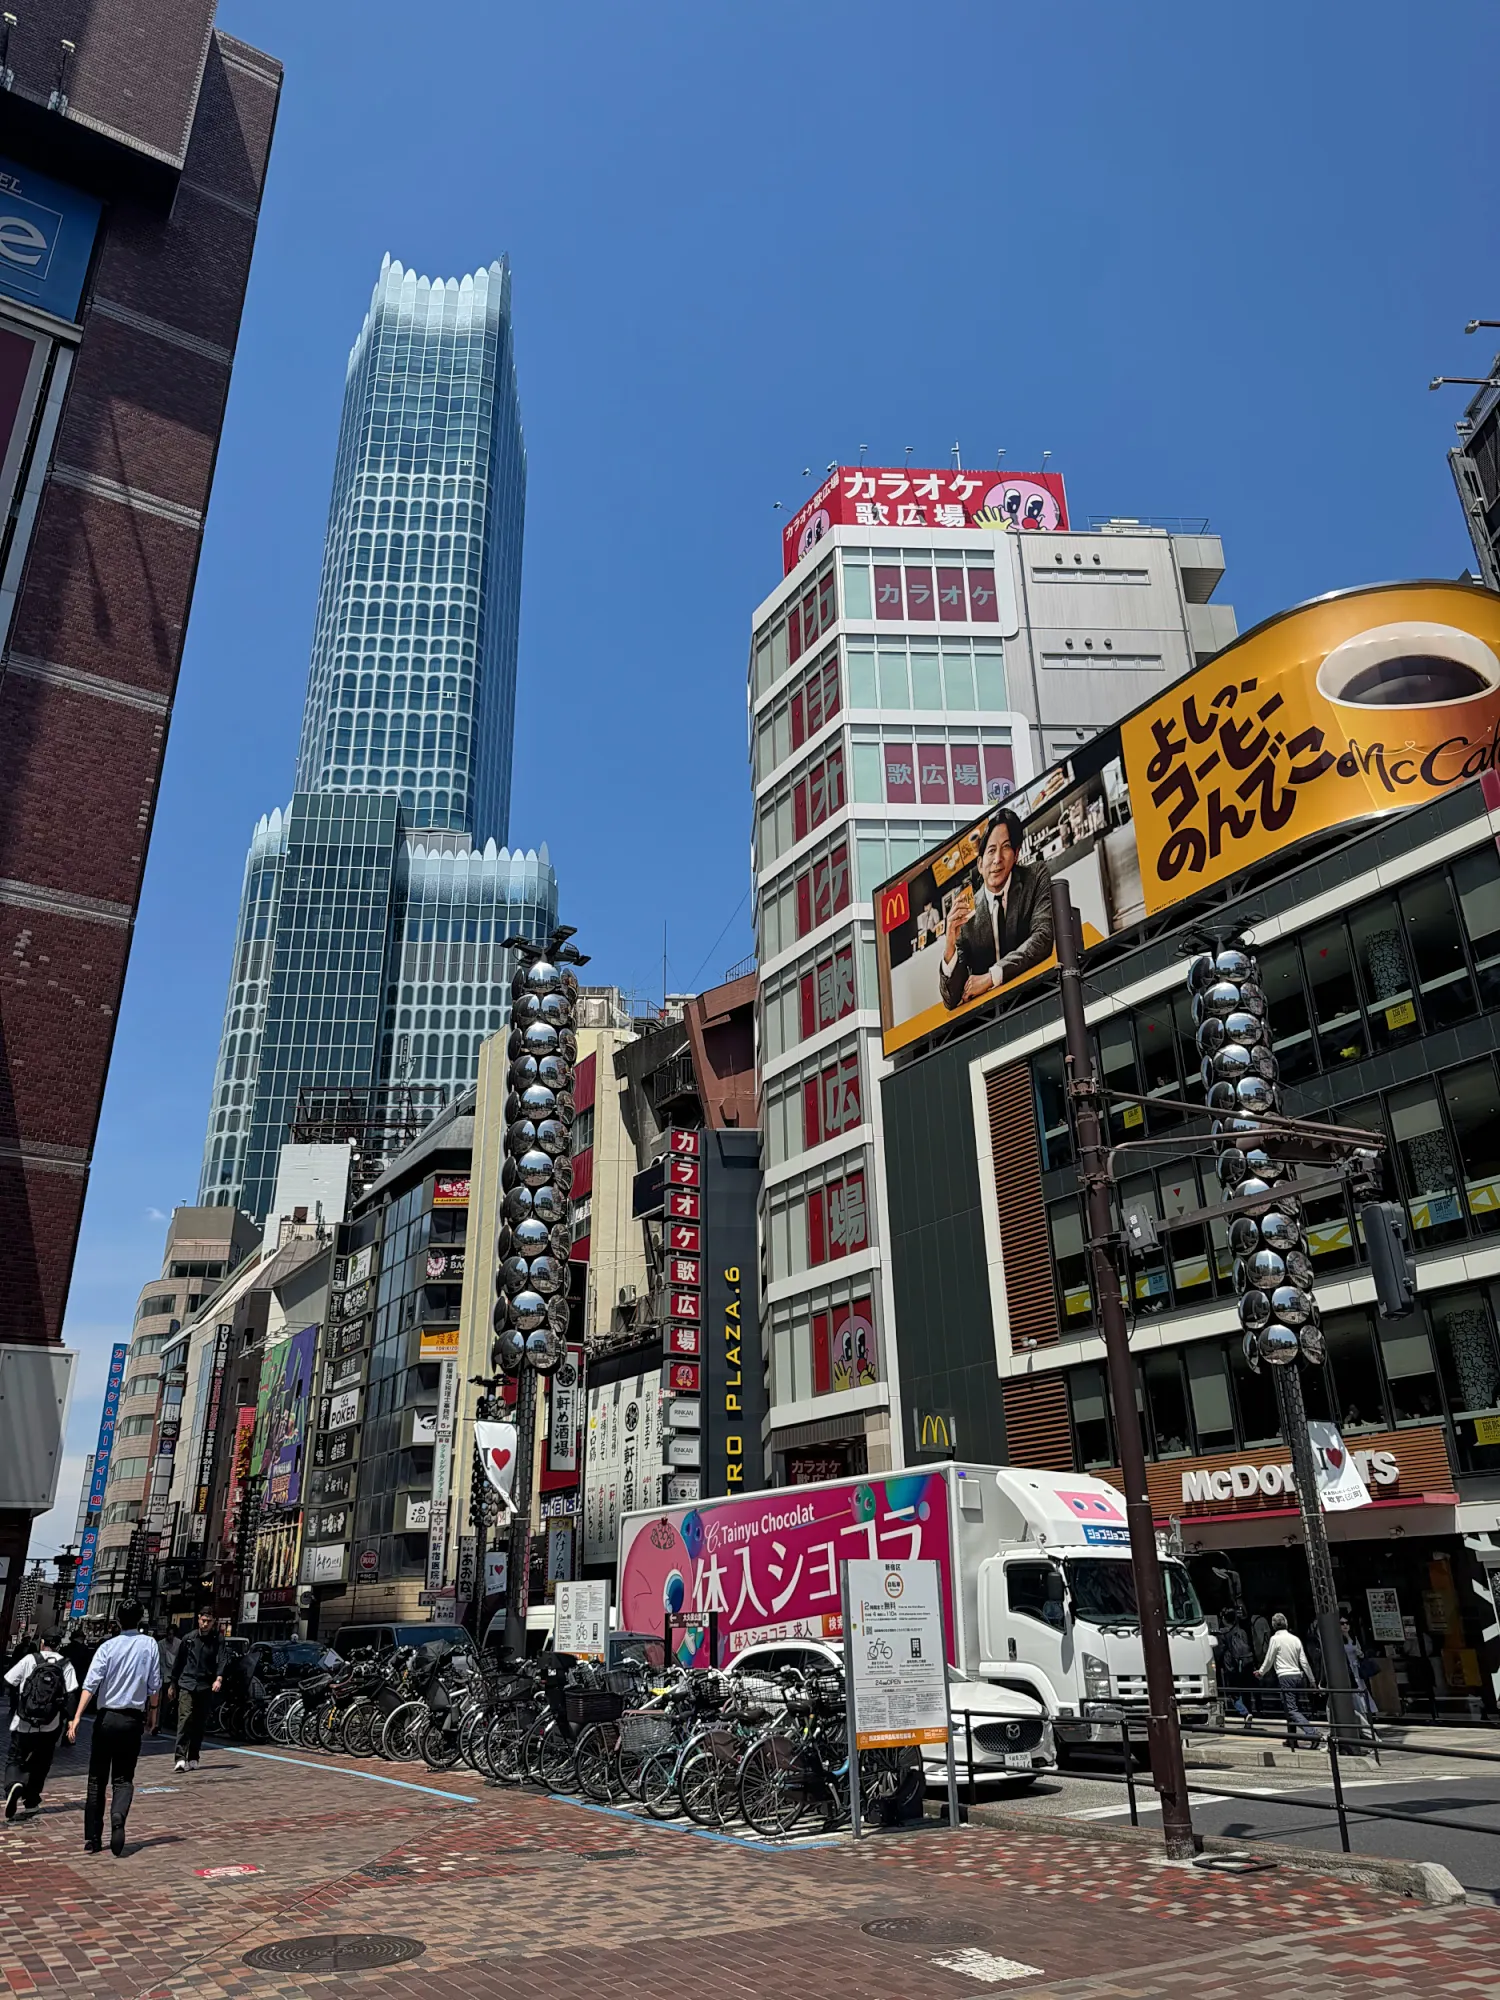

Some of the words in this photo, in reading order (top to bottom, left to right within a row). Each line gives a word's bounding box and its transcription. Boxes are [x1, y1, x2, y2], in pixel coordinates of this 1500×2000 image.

[843, 472, 983, 500] カラオケ
[785, 474, 840, 541] カラオケ歌広場
[855, 502, 966, 528] 歌広場
[878, 583, 994, 606] カラオケ
[886, 763, 979, 786] 歌広場
[1151, 692, 1285, 833] コーヒー
[676, 1131, 696, 1352] カラオケ歌広場
[331, 1405, 356, 1427] POKER
[554, 1389, 571, 1459] 一軒め酒場
[792, 1460, 843, 1474] カラオケ
[1316, 1447, 1329, 1470] I
[721, 1515, 760, 1545] Tainyu
[760, 1502, 815, 1534] Chocolat
[73, 1533, 96, 1611] カラオケ館
[692, 1505, 923, 1626] 体入ショコラ
[793, 1619, 813, 1638] 求人
